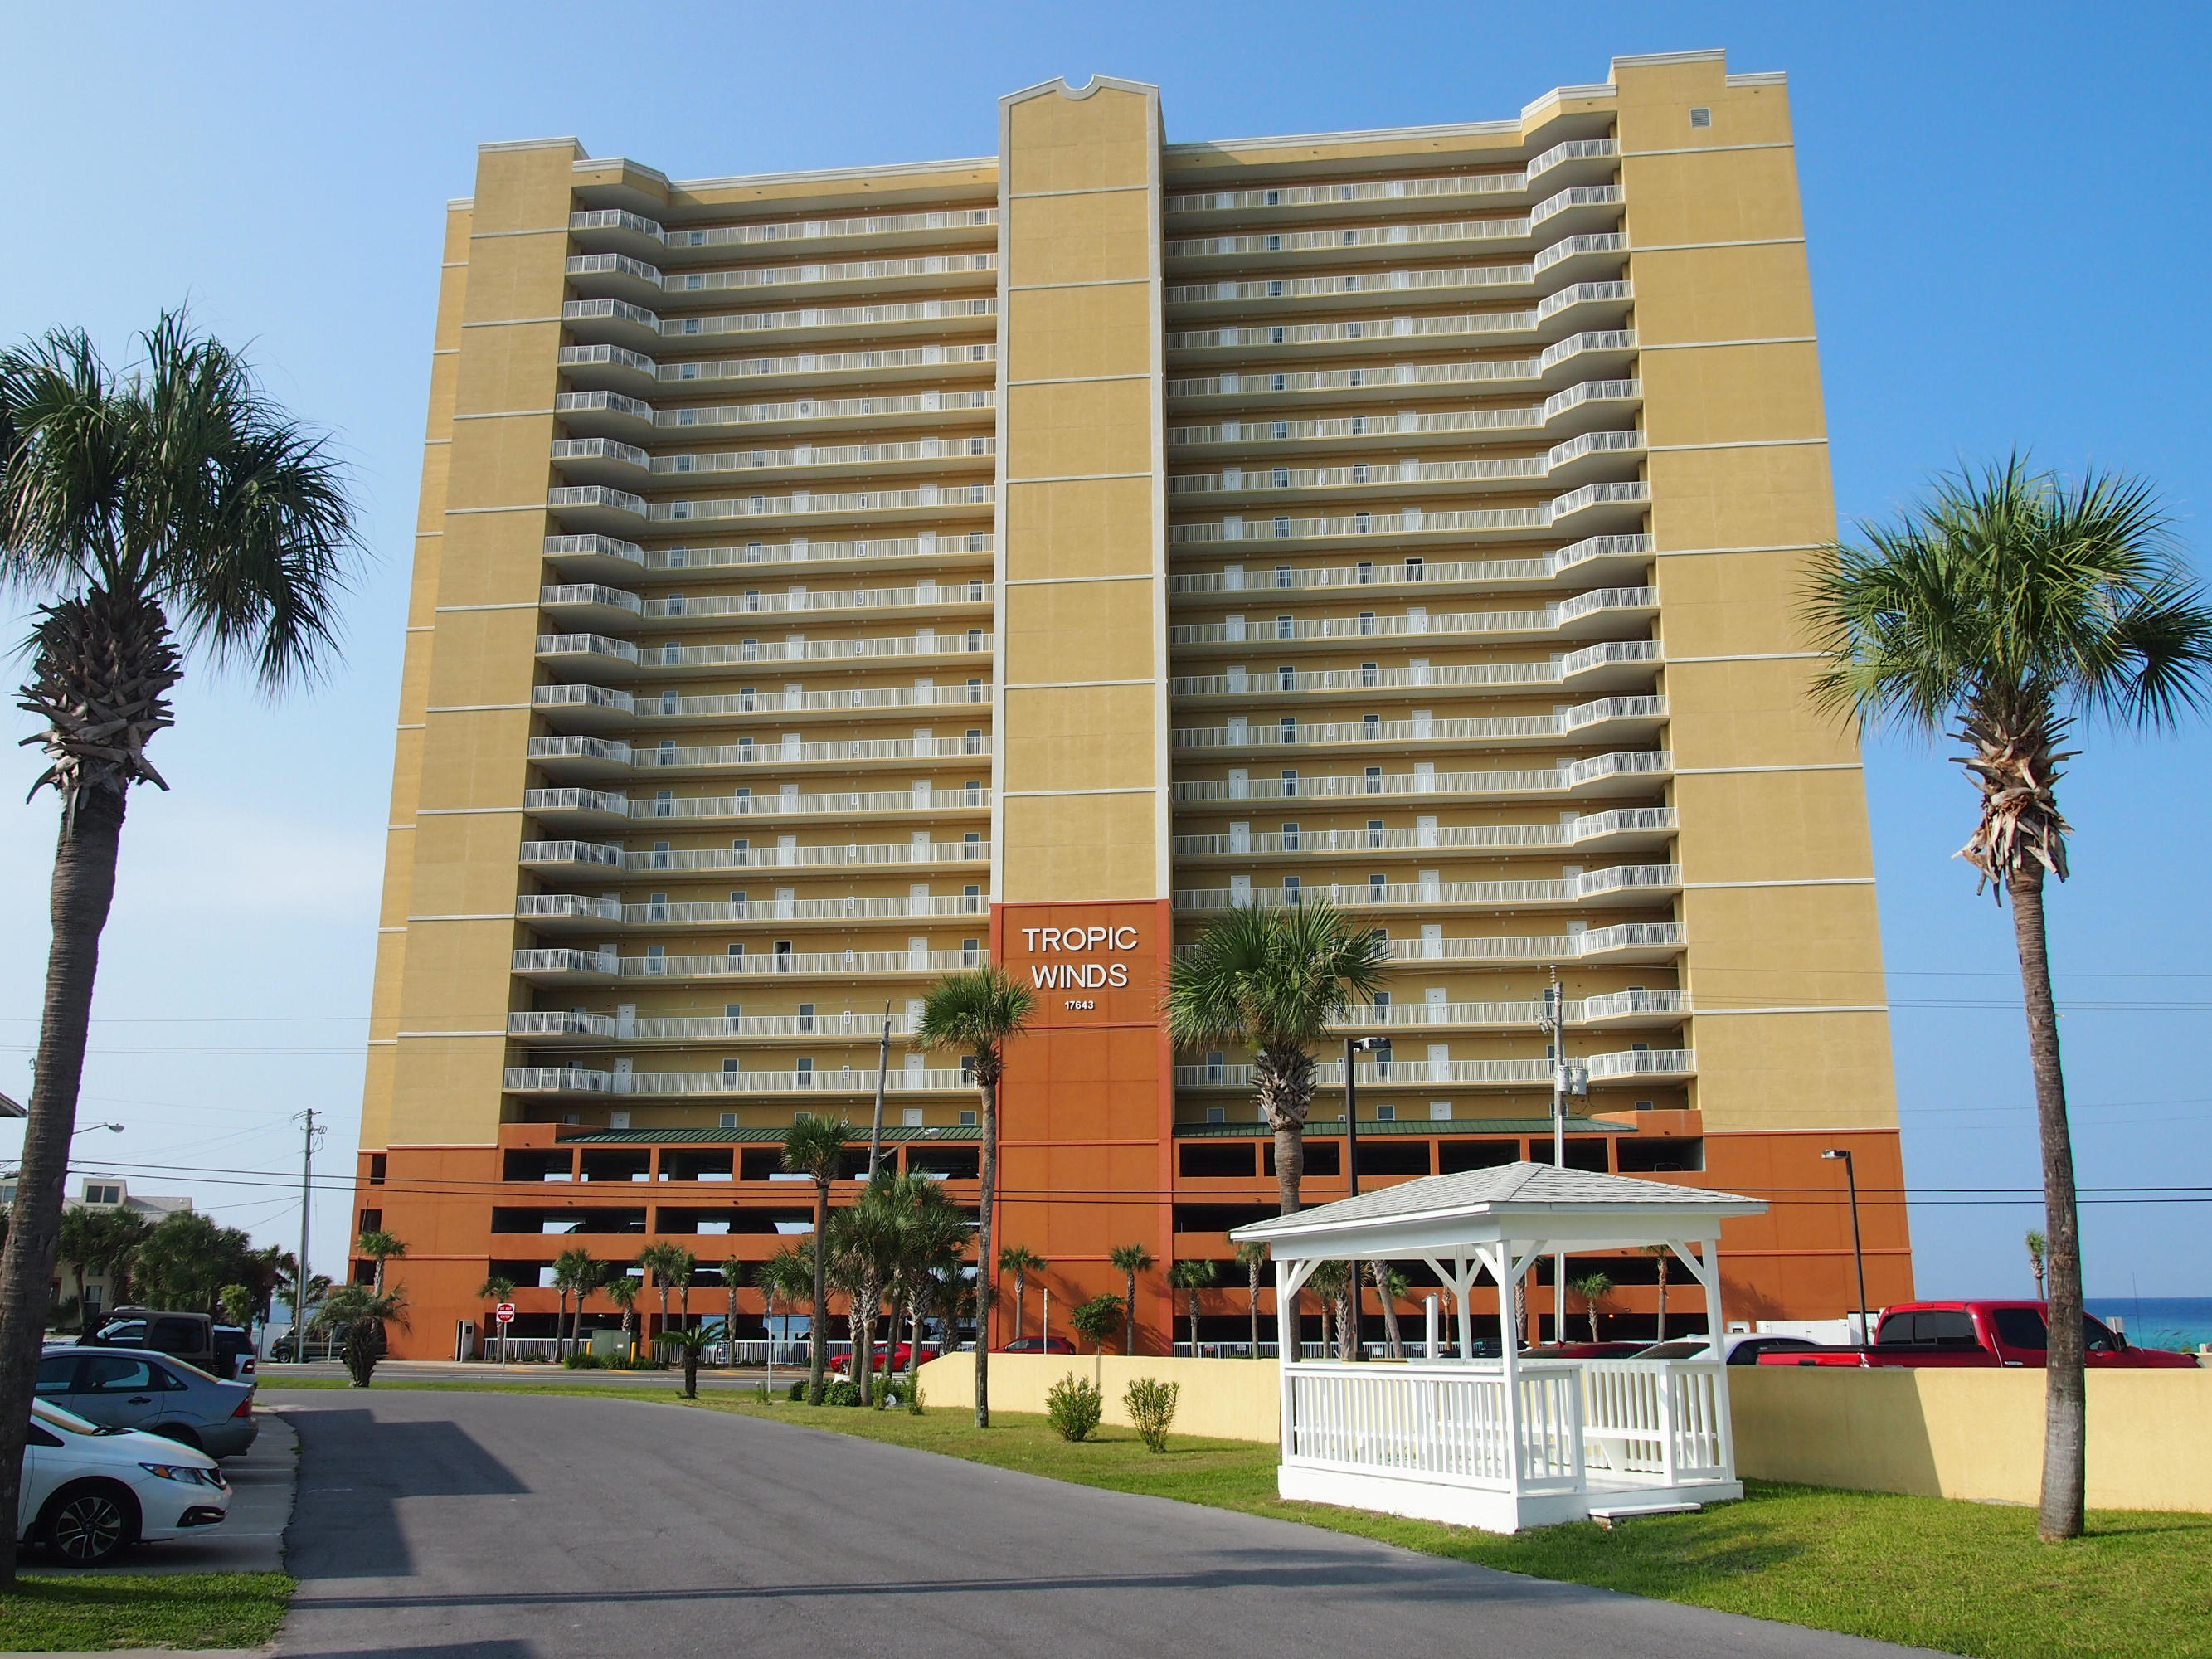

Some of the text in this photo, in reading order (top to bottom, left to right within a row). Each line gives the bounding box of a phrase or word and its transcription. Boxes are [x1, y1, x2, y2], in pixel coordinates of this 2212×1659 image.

[1021, 927, 1138, 951] TROPIC
[1031, 963, 1128, 989] WINDS
[1064, 1000, 1095, 1010] 17643
